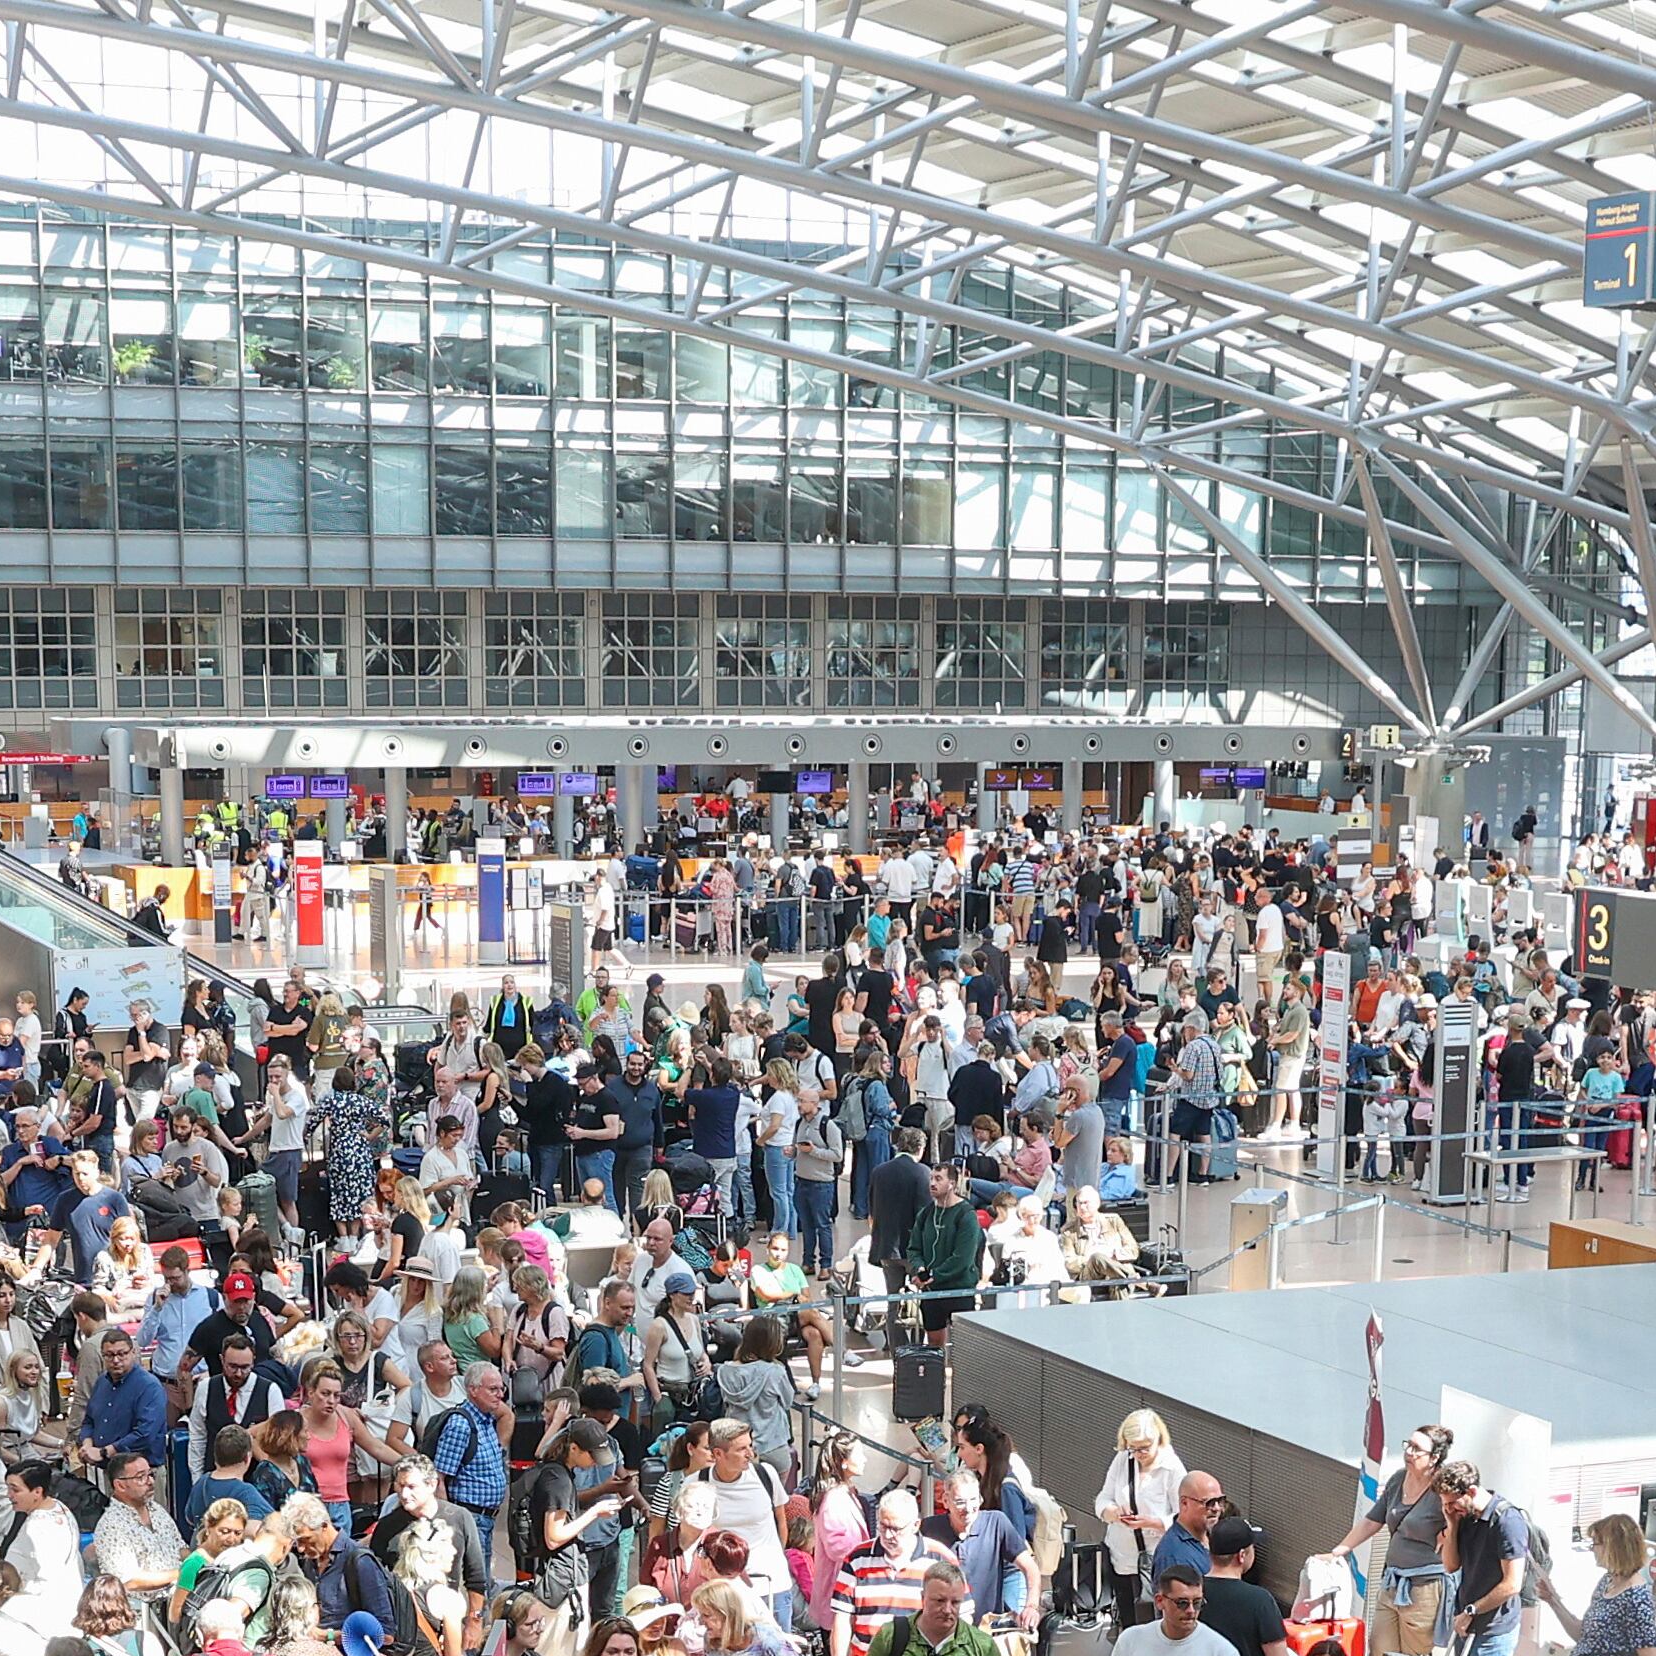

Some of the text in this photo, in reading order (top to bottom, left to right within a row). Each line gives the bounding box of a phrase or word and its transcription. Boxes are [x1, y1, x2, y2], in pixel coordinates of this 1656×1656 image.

[1624, 242, 1637, 287] 1
[1594, 278, 1621, 291] Terminal
[1343, 733, 1352, 751] 2
[1588, 904, 1609, 951] 3
[1588, 954, 1610, 965] Check-in
